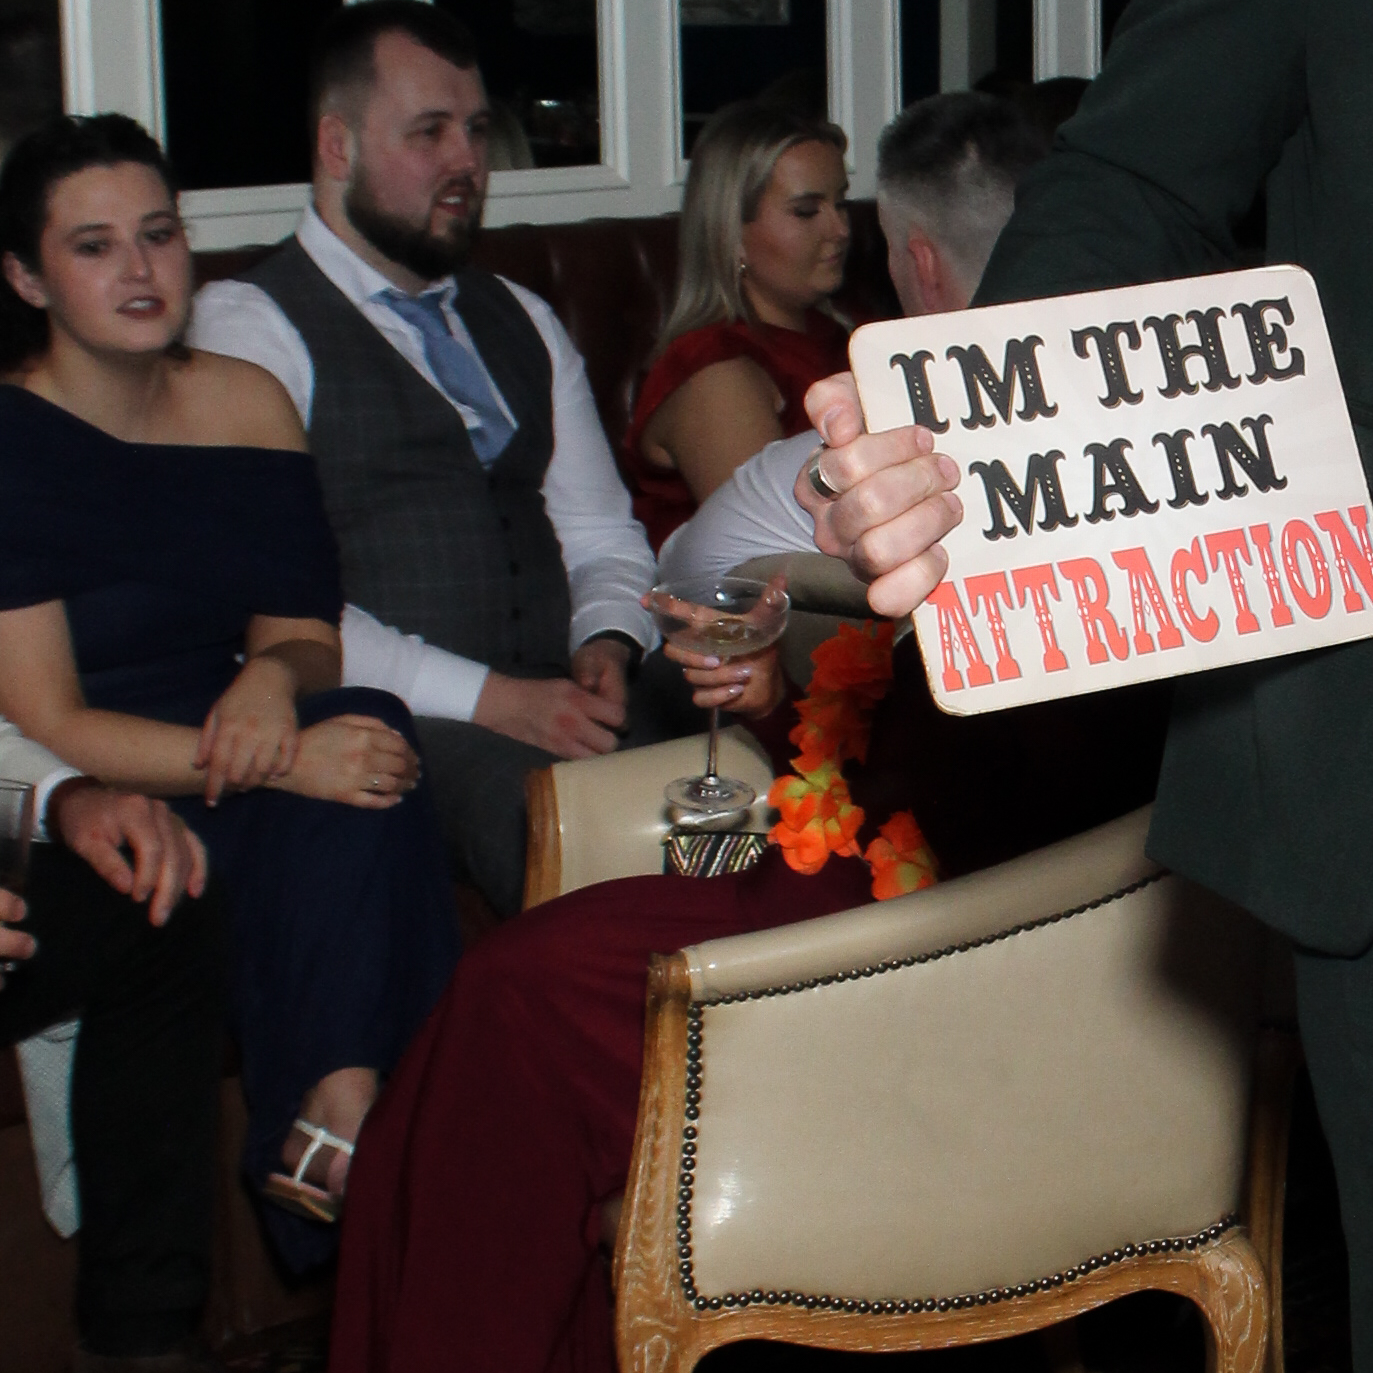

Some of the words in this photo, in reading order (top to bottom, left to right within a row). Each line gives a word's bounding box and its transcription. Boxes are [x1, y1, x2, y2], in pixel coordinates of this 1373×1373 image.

[890, 335, 1057, 433] IM
[1071, 297, 1305, 408] THE
[968, 414, 1287, 541] MAIN
